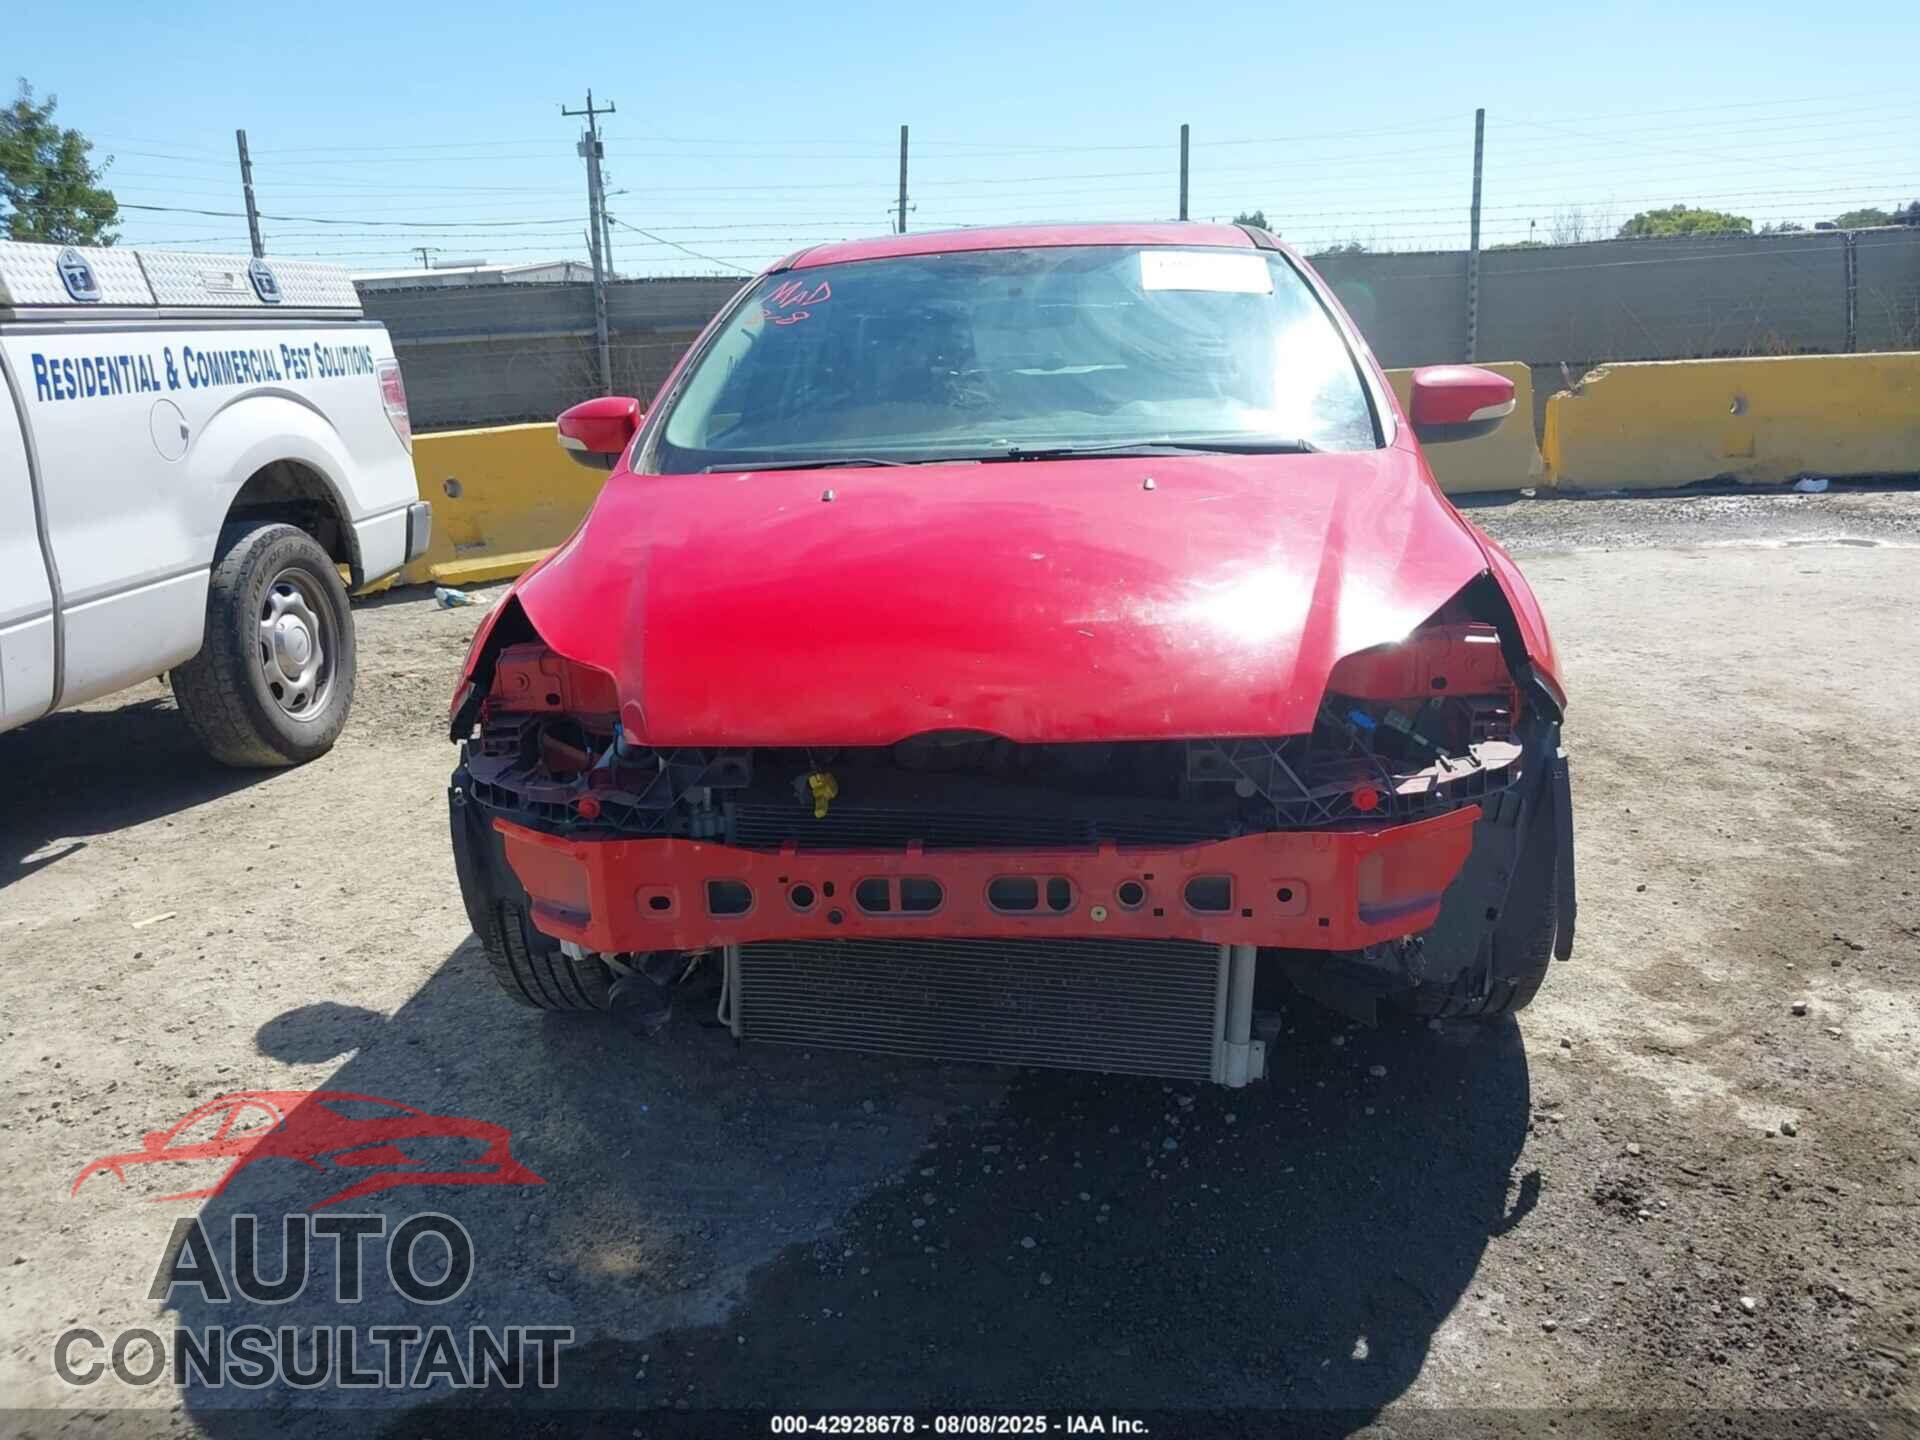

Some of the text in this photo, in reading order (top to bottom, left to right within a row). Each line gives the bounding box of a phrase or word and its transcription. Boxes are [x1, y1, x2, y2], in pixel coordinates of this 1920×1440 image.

[32, 342, 374, 401] RESIDENTIAL & COMMERCIAL PEST SOLUTIONS
